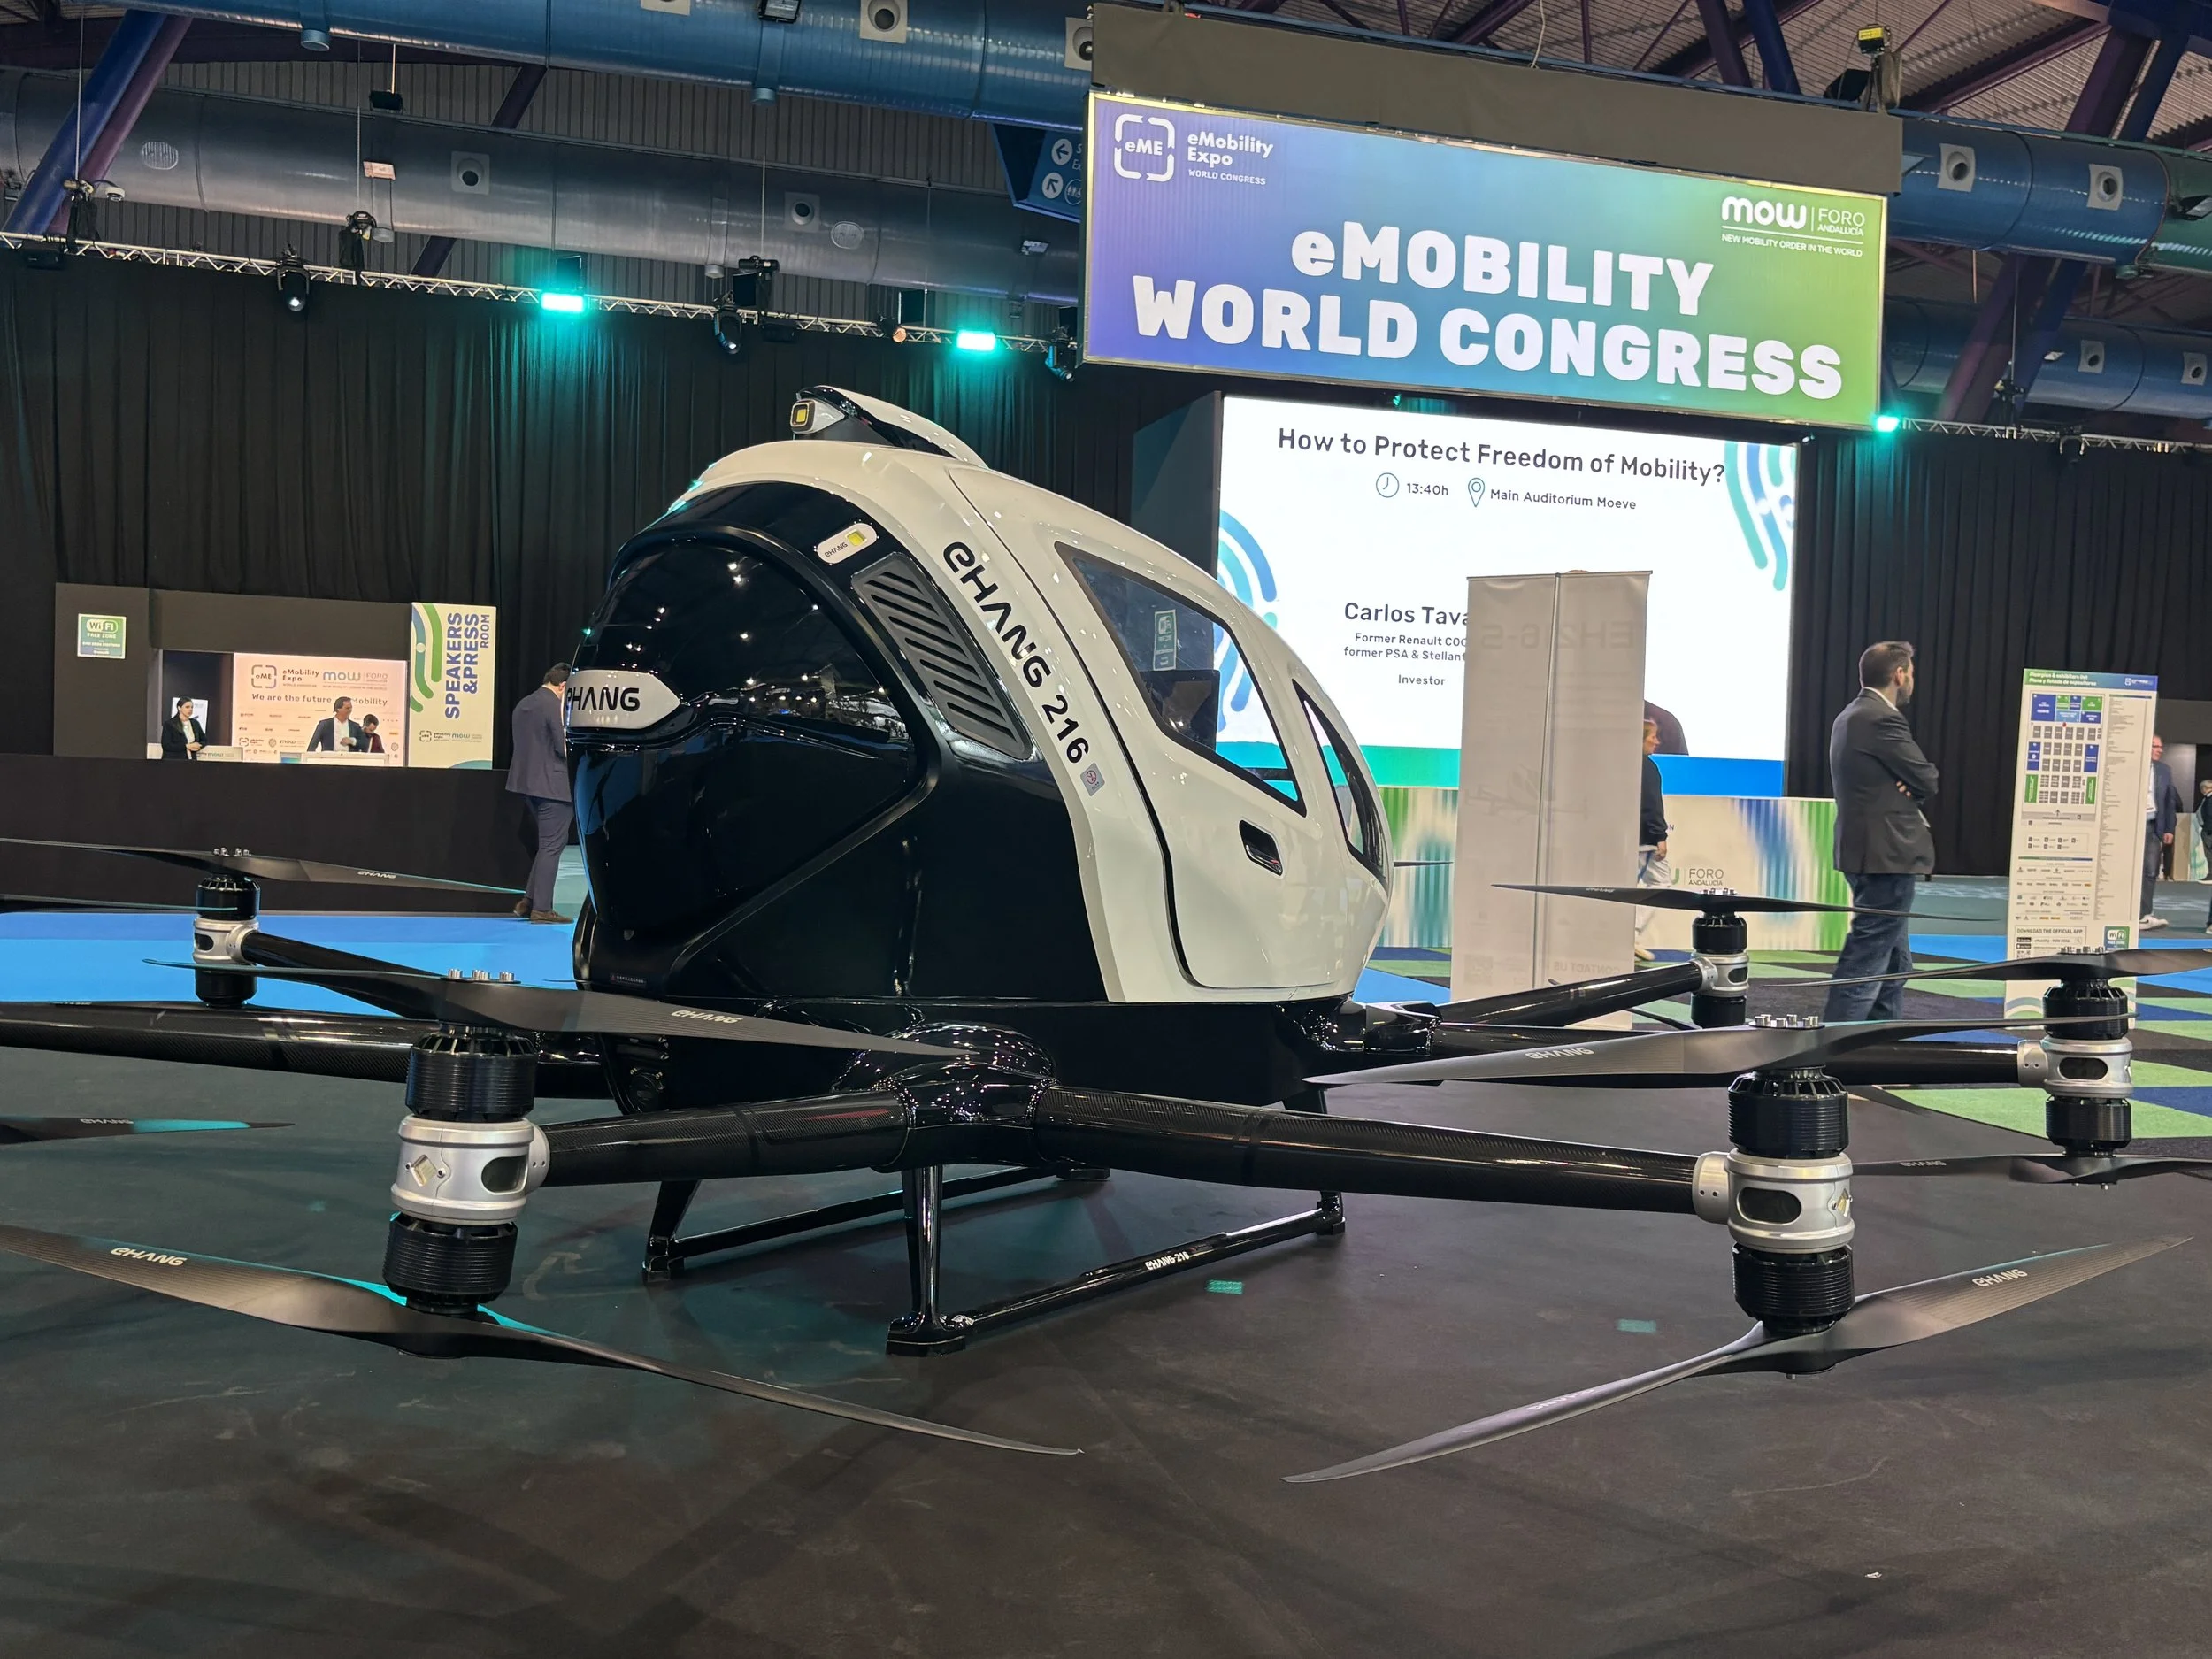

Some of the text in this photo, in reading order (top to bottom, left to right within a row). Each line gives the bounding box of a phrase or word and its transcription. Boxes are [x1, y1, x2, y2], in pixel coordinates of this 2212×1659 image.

[1125, 138, 1163, 156] eME
[1187, 131, 1273, 158] eMobility
[1187, 147, 1233, 168] Expo
[1188, 169, 1266, 186] WORLD CONGRESS
[1818, 208, 1865, 227] FORO
[1722, 234, 1863, 257] NEW MOBILITY ORDER IN THE WORLD
[1291, 220, 1715, 317] eMOBILITY
[1132, 274, 1843, 401] WORLD CONGRESS
[1279, 427, 1725, 487] How to Protect Freedom of Mobility?
[1406, 482, 1449, 496] 13:40h
[1490, 488, 1637, 511] Main Auditorium Moeve
[1345, 602, 1416, 623] Carlos
[480, 614, 490, 649] ROOM
[1355, 633, 1396, 643] Former
[1399, 634, 1442, 646] Renault
[1344, 647, 1383, 657] former
[1386, 649, 1409, 659] PSA
[1411, 650, 1419, 659] &
[282, 669, 320, 678] eMobility
[445, 612, 463, 719] SPEAKERS
[1398, 674, 1446, 686] Investor
[303, 695, 332, 703] future
[1041, 694, 1090, 764] 216
[1689, 868, 1724, 879] FORO
